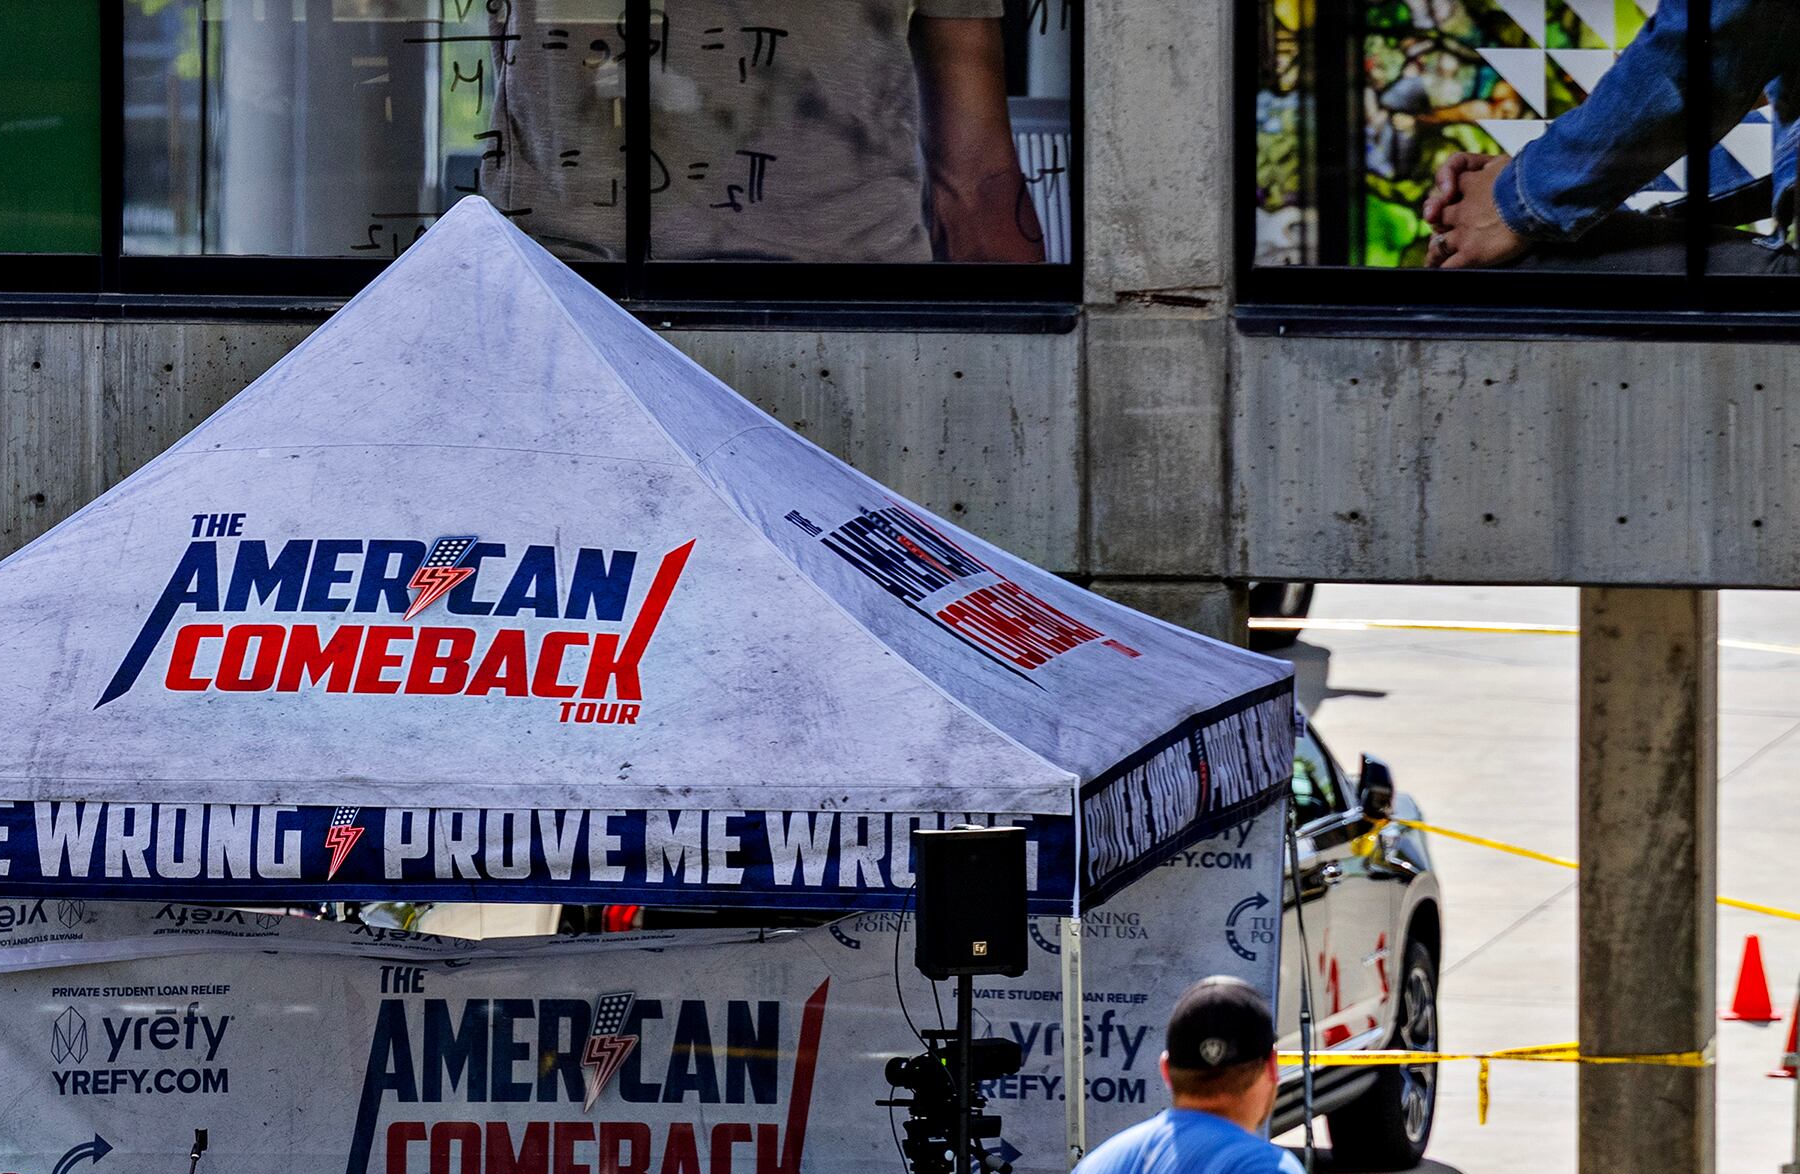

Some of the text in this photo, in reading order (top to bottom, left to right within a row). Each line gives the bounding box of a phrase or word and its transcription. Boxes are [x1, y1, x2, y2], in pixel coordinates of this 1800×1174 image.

[191, 513, 246, 537] THE
[784, 509, 823, 537] THE
[165, 537, 696, 700] COMEBACK
[558, 700, 641, 725] TOUR
[33, 801, 302, 880] WRONG
[384, 807, 1040, 892] PROVE ME WRO
[1160, 851, 1252, 869] FY.COM
[51, 932, 83, 941] PRIVATE
[855, 921, 911, 932] POINT
[1116, 926, 1149, 939] USA
[13, 935, 49, 944] STUDENT
[52, 984, 231, 997] PRIVATE STUDENT LOAN RELIEF
[380, 965, 425, 994] THE
[1110, 992, 1149, 1004] RELIEF
[52, 1068, 229, 1096] YREFY.COM
[977, 1075, 1146, 1103] REFY.COM
